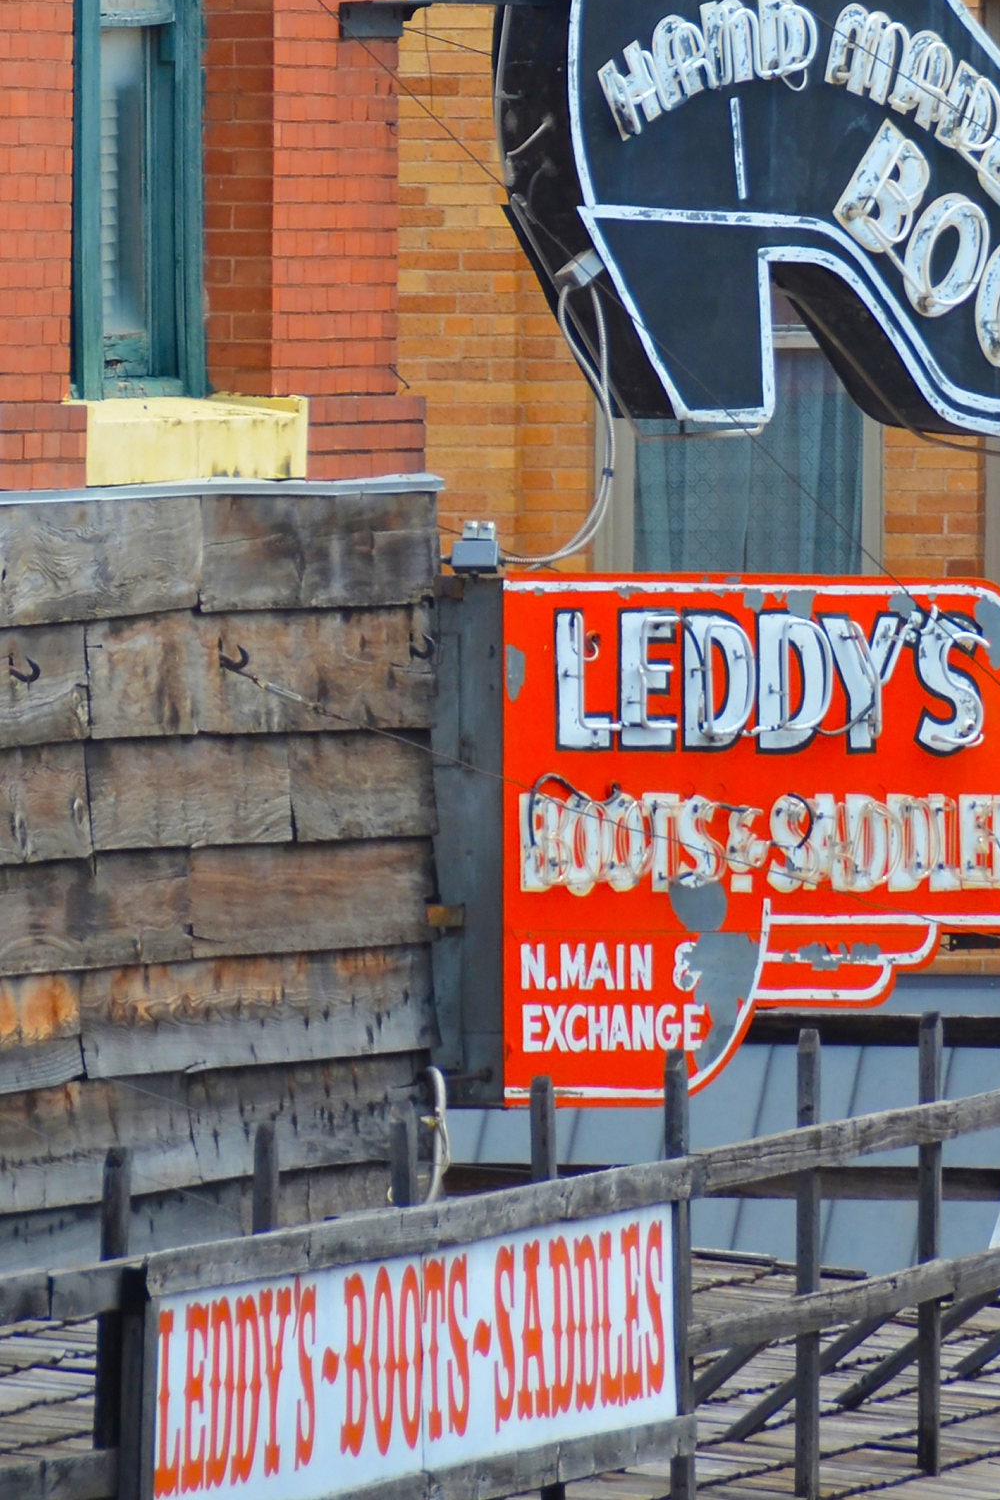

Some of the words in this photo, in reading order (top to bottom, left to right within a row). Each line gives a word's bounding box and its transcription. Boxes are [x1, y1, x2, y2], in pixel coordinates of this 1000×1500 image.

[553, 606, 990, 757] LEDDY'S
[519, 792, 726, 896] BOOTS
[521, 1005, 704, 1052] EXCHANGE
[153, 1275, 316, 1498] LEDDY'S
[341, 1252, 471, 1458] BOOTS
[494, 1219, 665, 1433] SADDLES
